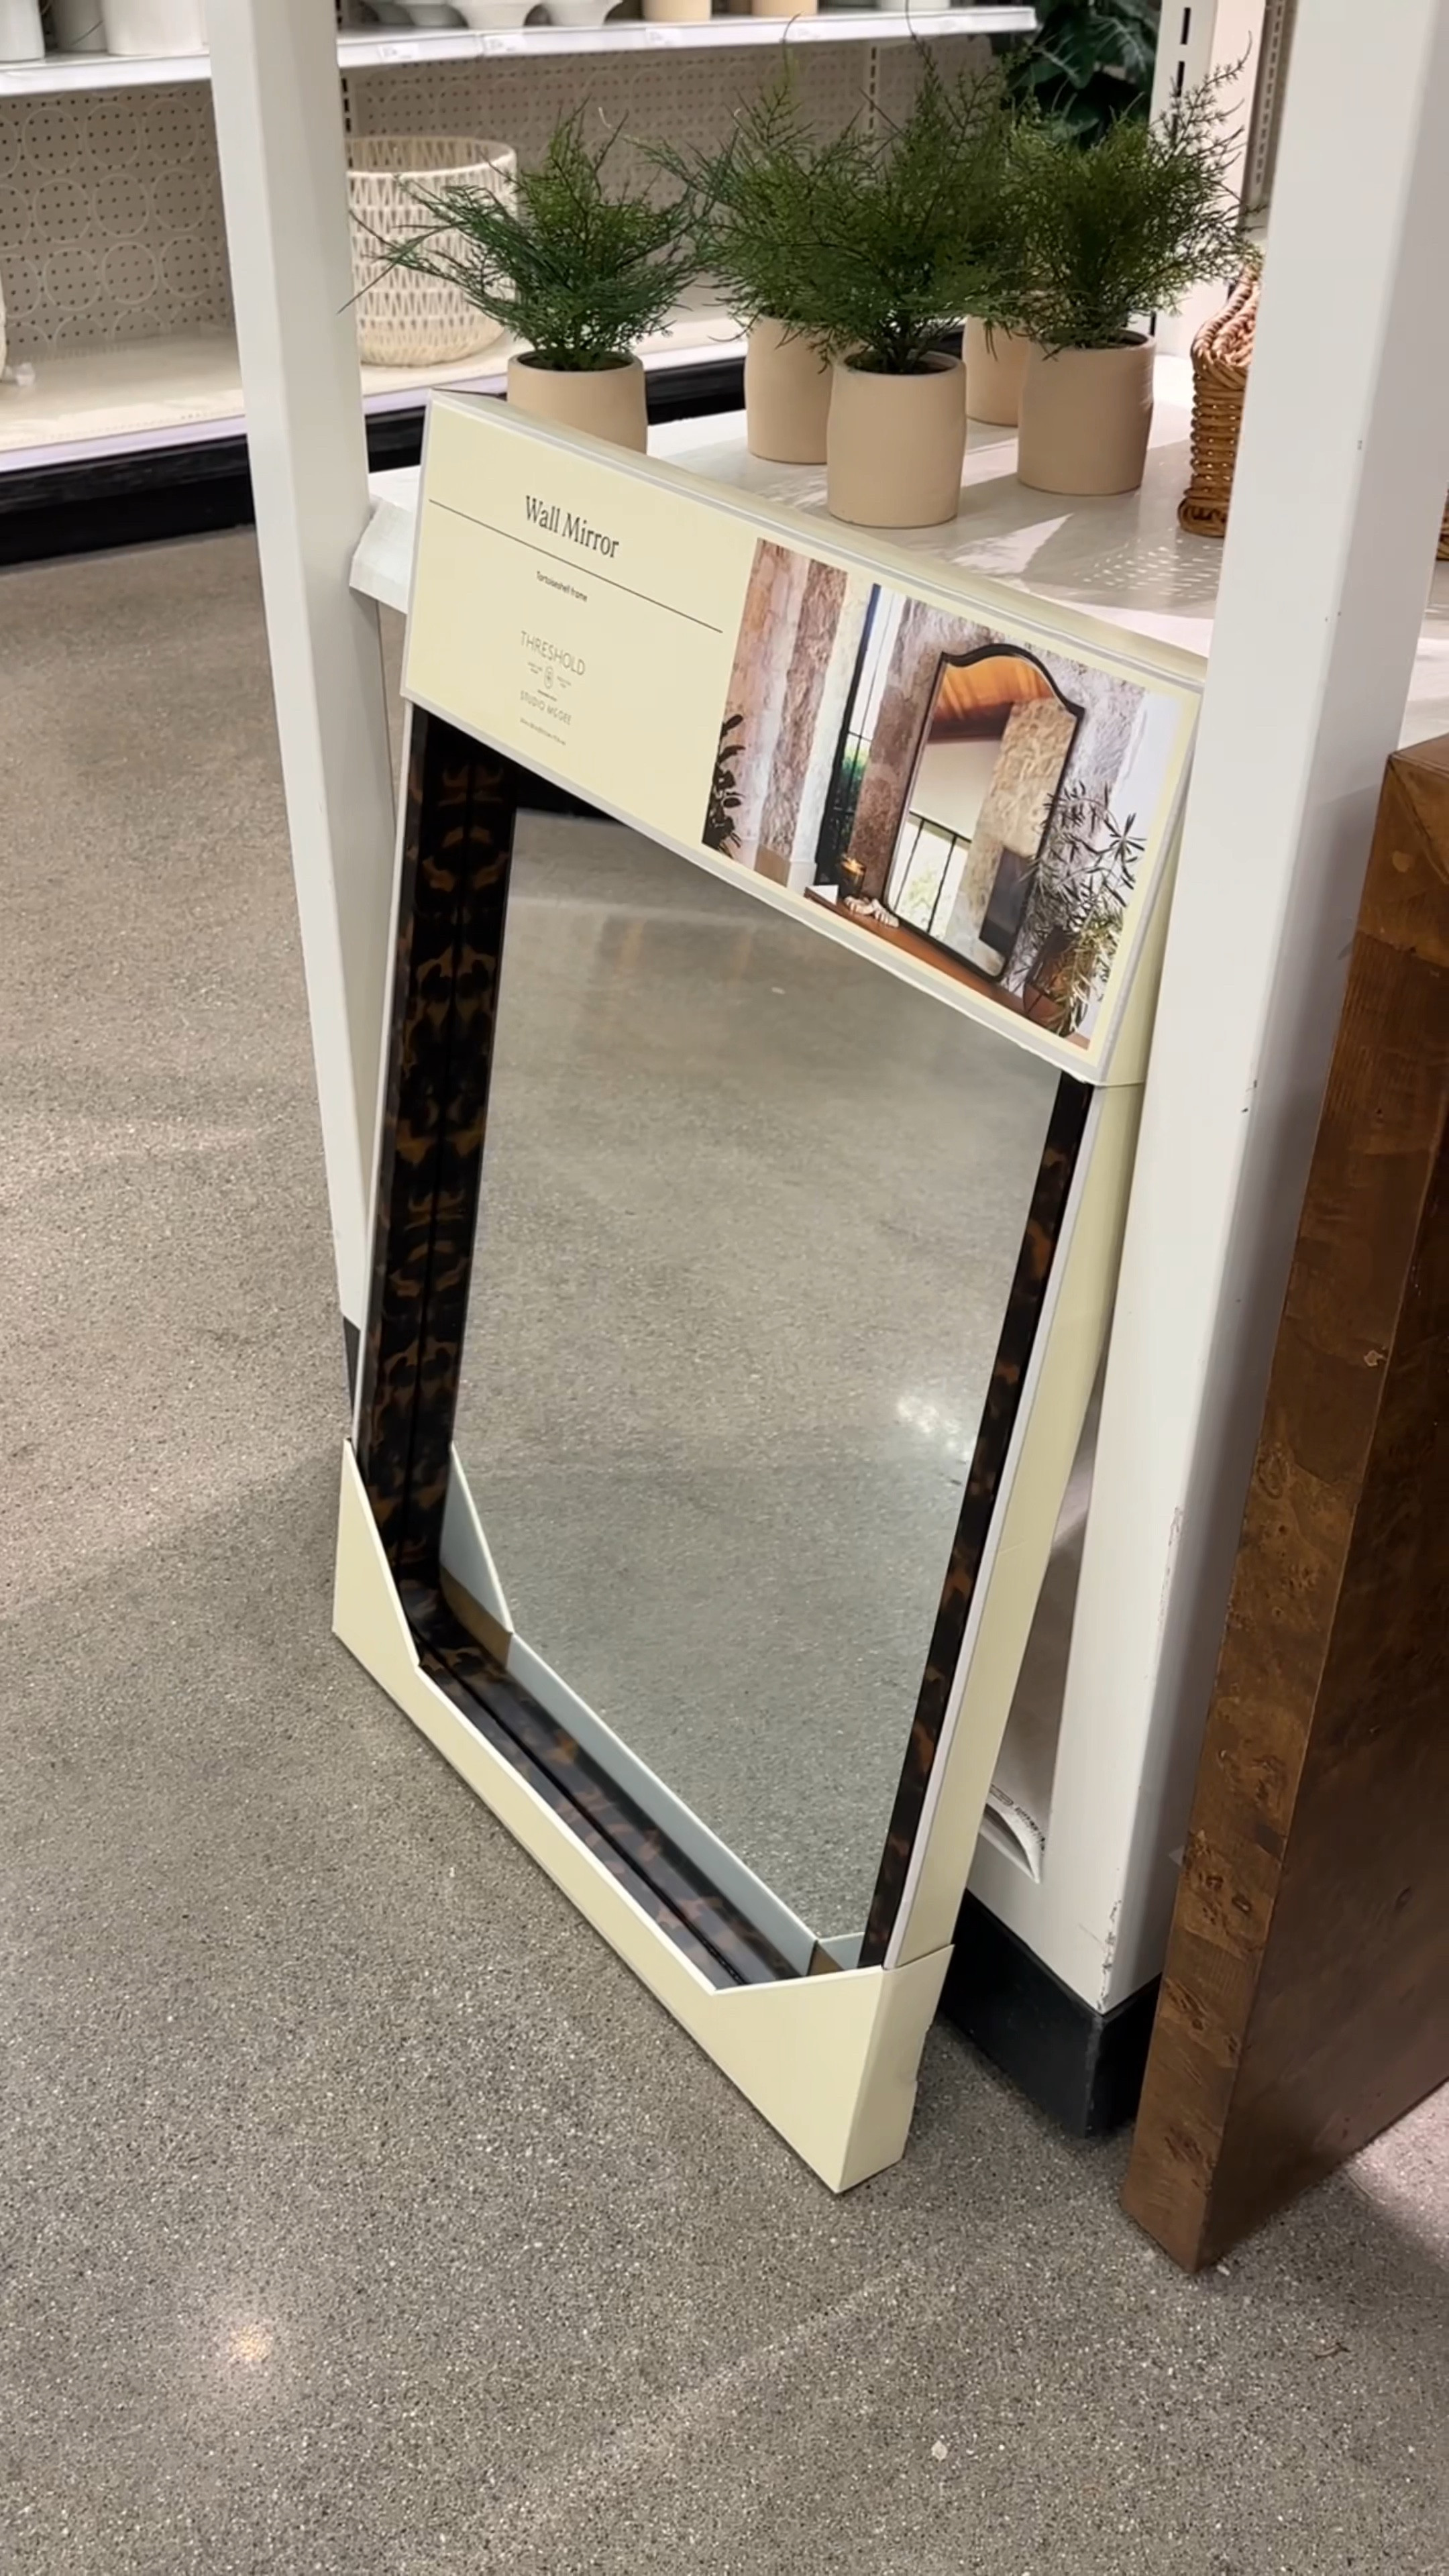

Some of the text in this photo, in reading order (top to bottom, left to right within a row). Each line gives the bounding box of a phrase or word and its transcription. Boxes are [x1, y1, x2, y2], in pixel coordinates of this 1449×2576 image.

[525, 495, 620, 558] Wall Mirror
[521, 630, 586, 676] THRESHOLD
